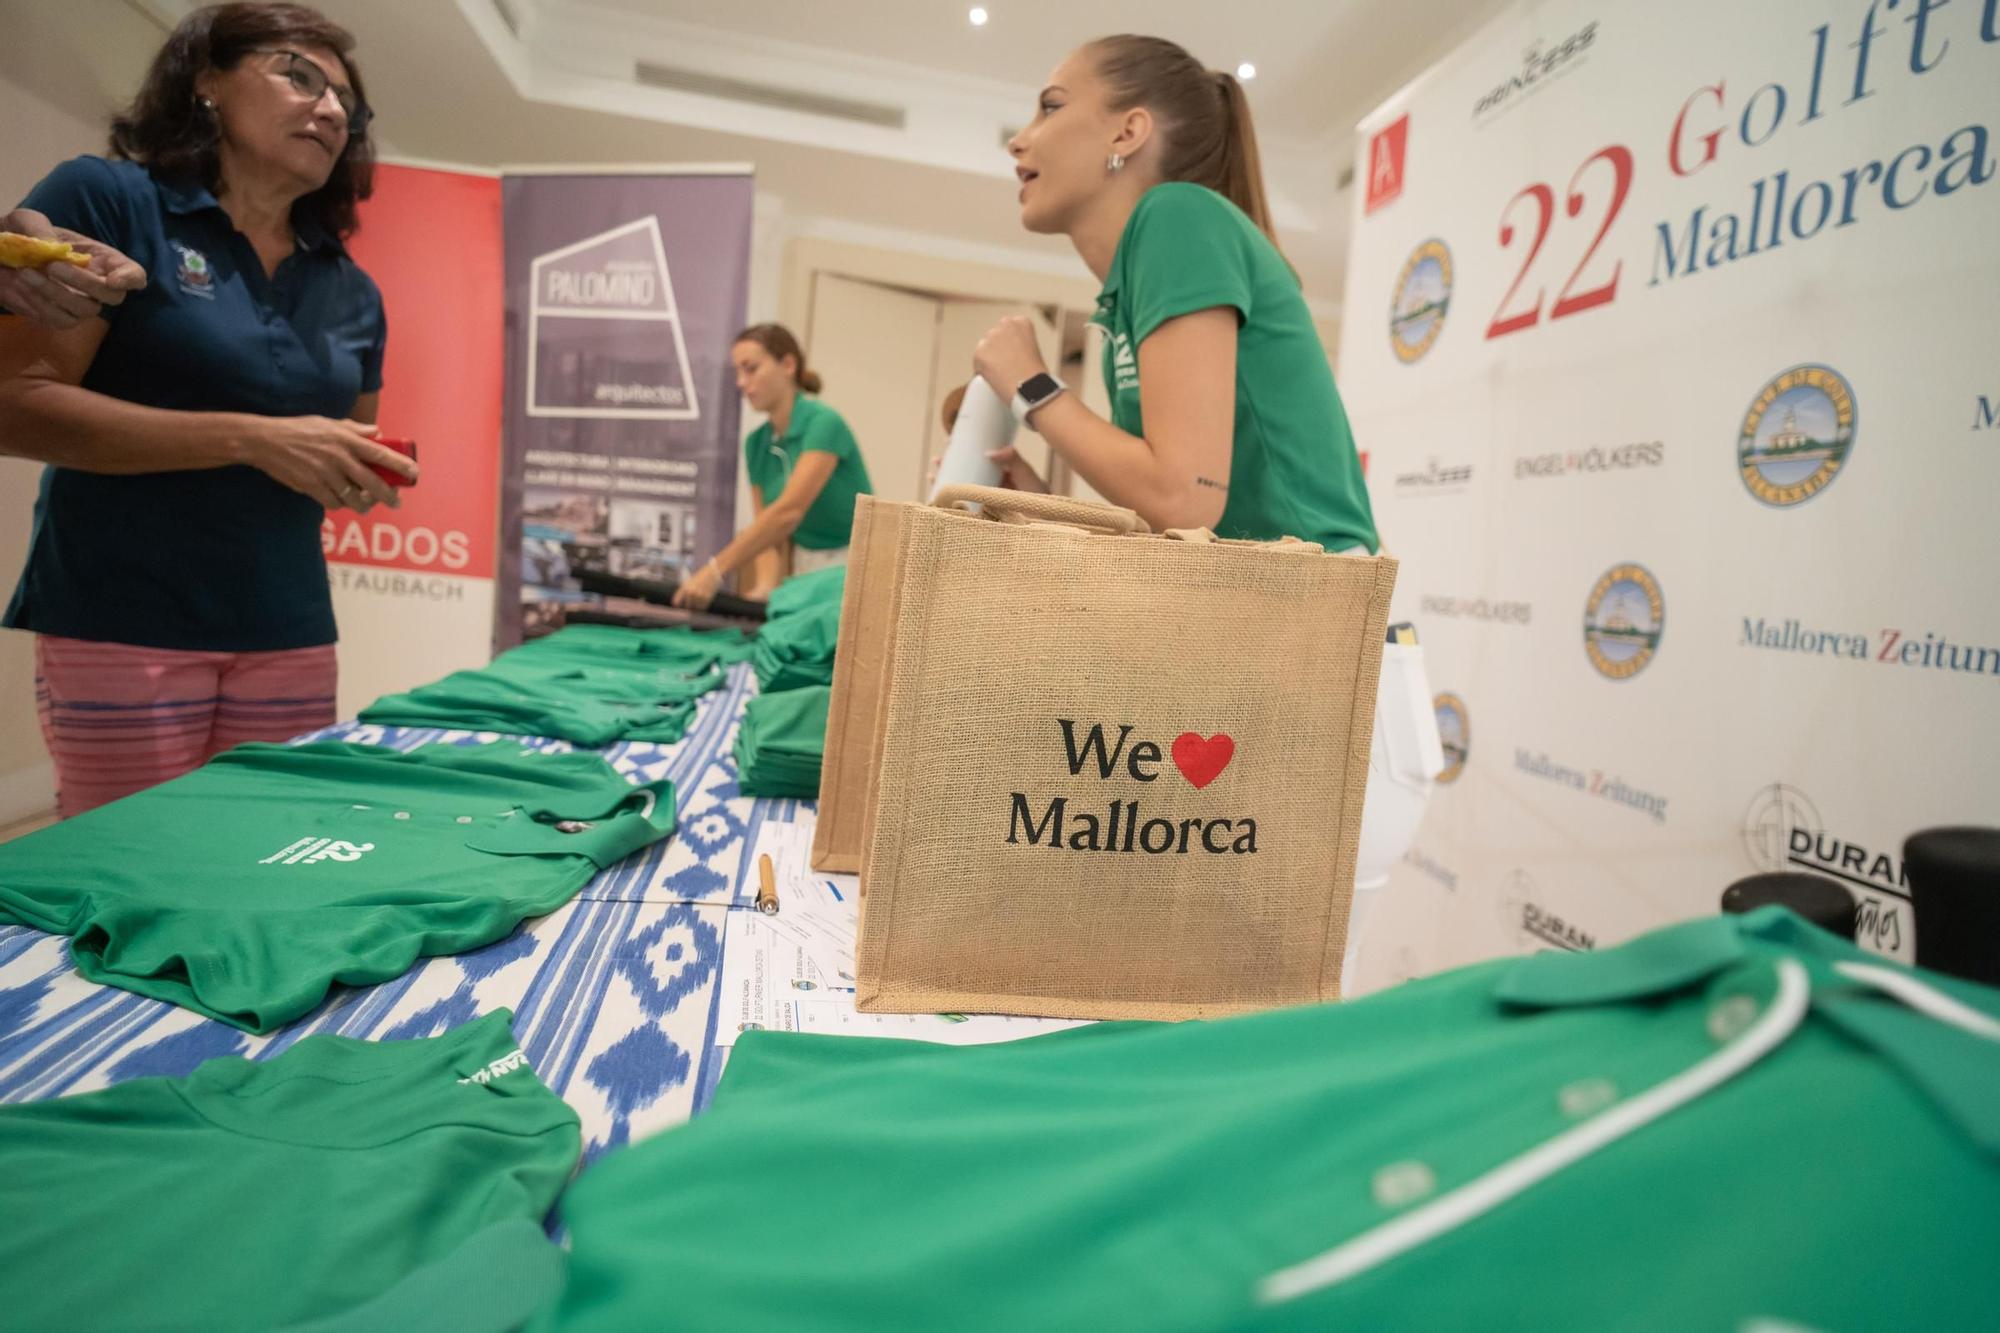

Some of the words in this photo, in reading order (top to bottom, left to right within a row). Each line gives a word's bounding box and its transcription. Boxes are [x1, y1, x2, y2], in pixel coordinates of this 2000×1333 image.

[1647, 123, 1997, 288] Mallorca
[1485, 143, 1634, 341] 22
[549, 270, 656, 306] PALOMINO
[595, 380, 684, 406] arquitectos
[1741, 616, 1869, 660] Mallorca
[1057, 718, 1162, 782] We
[1004, 791, 1258, 854] Mallorca
